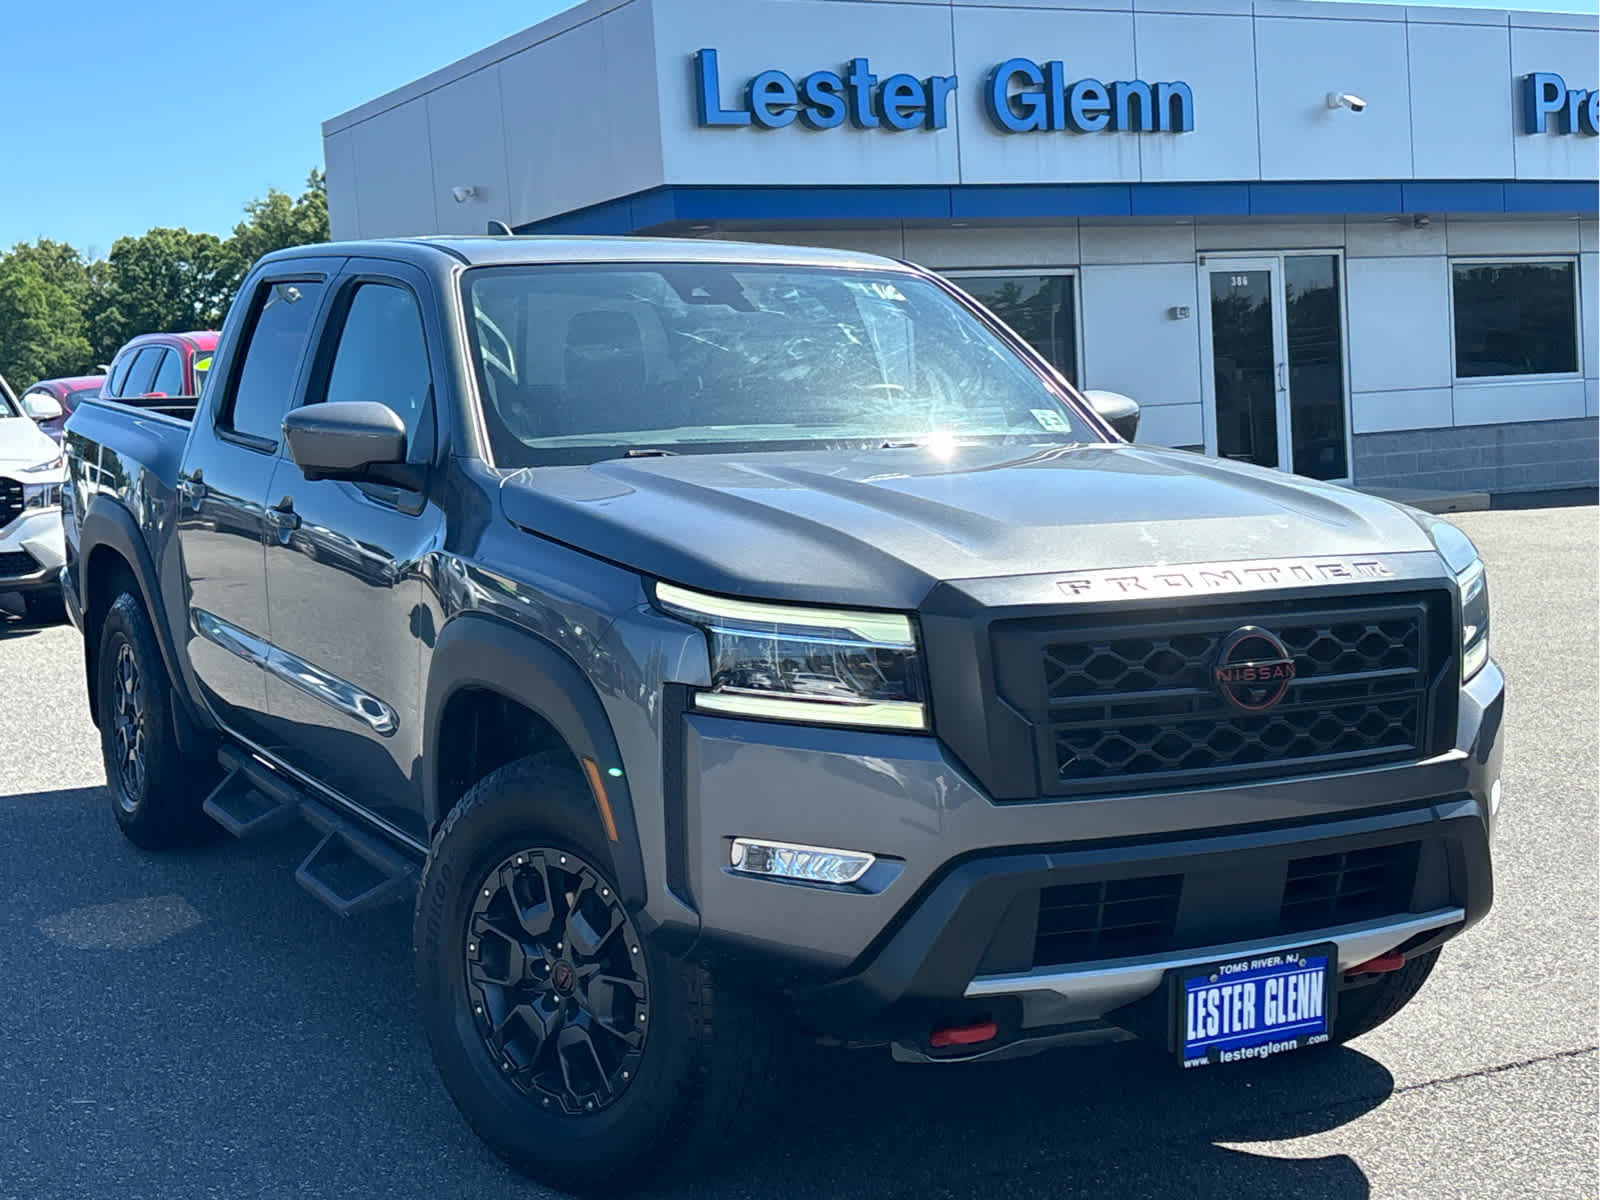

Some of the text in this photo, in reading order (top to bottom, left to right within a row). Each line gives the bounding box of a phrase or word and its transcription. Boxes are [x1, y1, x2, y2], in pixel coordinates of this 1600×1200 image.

[696, 48, 1194, 132] Lester Glenn
[1056, 562, 1395, 595] FRONTIER
[1216, 662, 1296, 681] NISSAN
[1219, 962, 1248, 976] TOMS
[1286, 953, 1299, 964] NJ
[1187, 971, 1324, 1041] LESTER GLENN
[1220, 1039, 1298, 1063] lesterglenn
